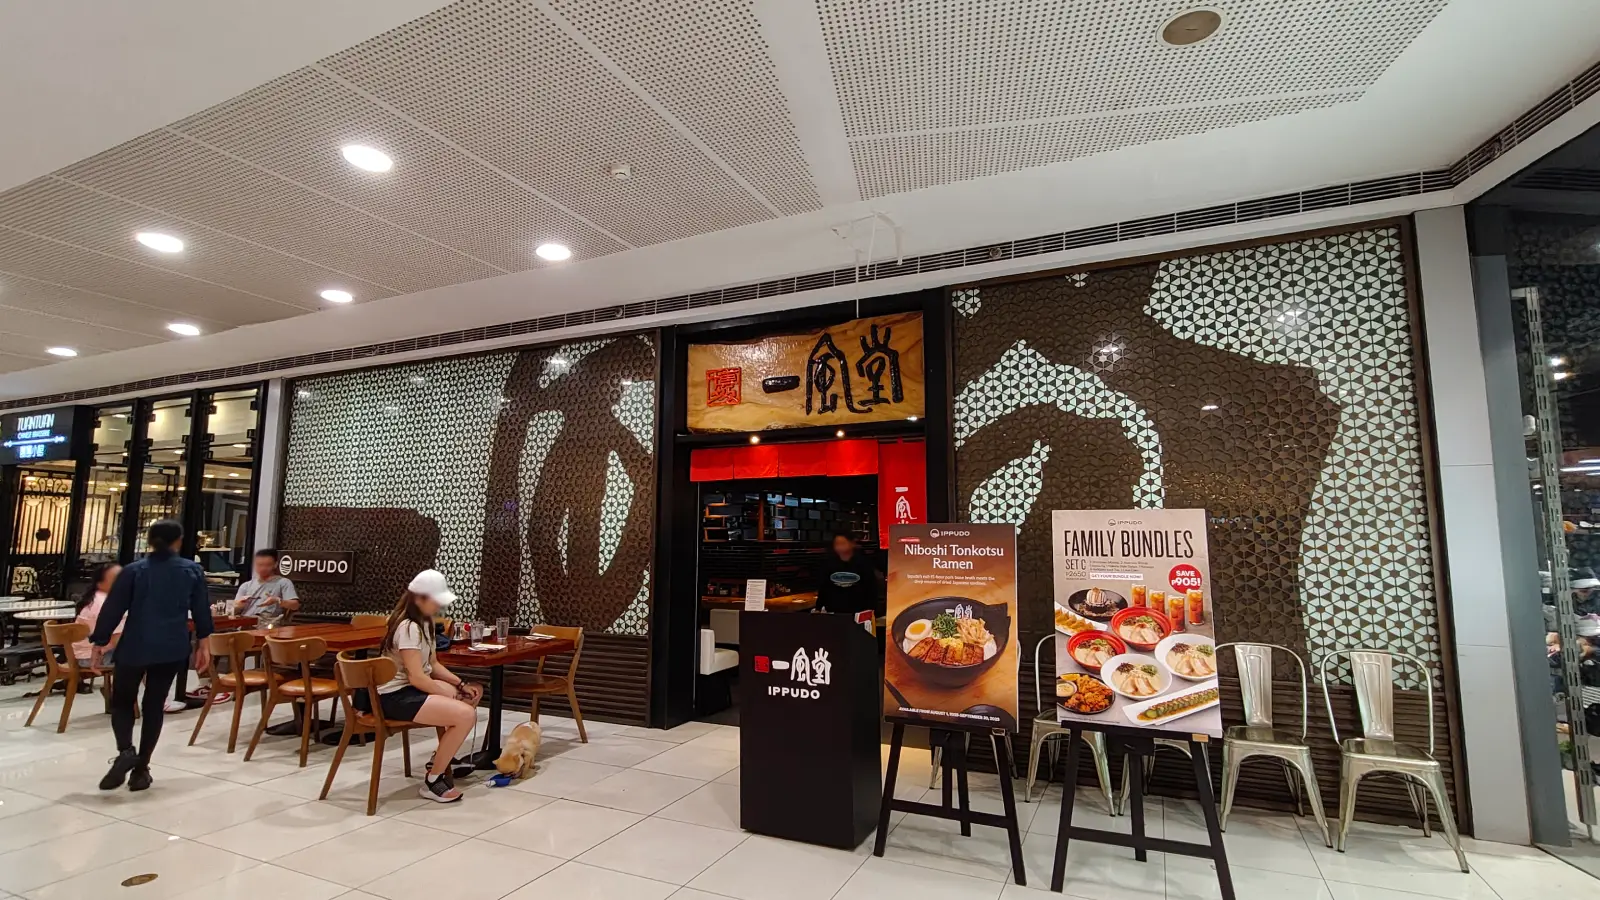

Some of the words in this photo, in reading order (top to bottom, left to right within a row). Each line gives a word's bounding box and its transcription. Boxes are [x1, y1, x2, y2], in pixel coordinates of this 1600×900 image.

[762, 324, 904, 416] 一風堂
[17, 413, 55, 431] TUANTUAN
[895, 486, 918, 525] 一風
[904, 544, 948, 556] Niboshi
[949, 544, 1004, 557] Tonkotsu
[1064, 530, 1116, 557] FAMILY
[1121, 530, 1194, 559] BUNDLES
[294, 559, 348, 574] IPPUDO
[932, 558, 973, 570] Ramen
[1065, 558, 1079, 570] SET
[1081, 558, 1087, 571] C
[771, 647, 832, 687] 一風堂
[768, 686, 820, 700] IPPUDO
